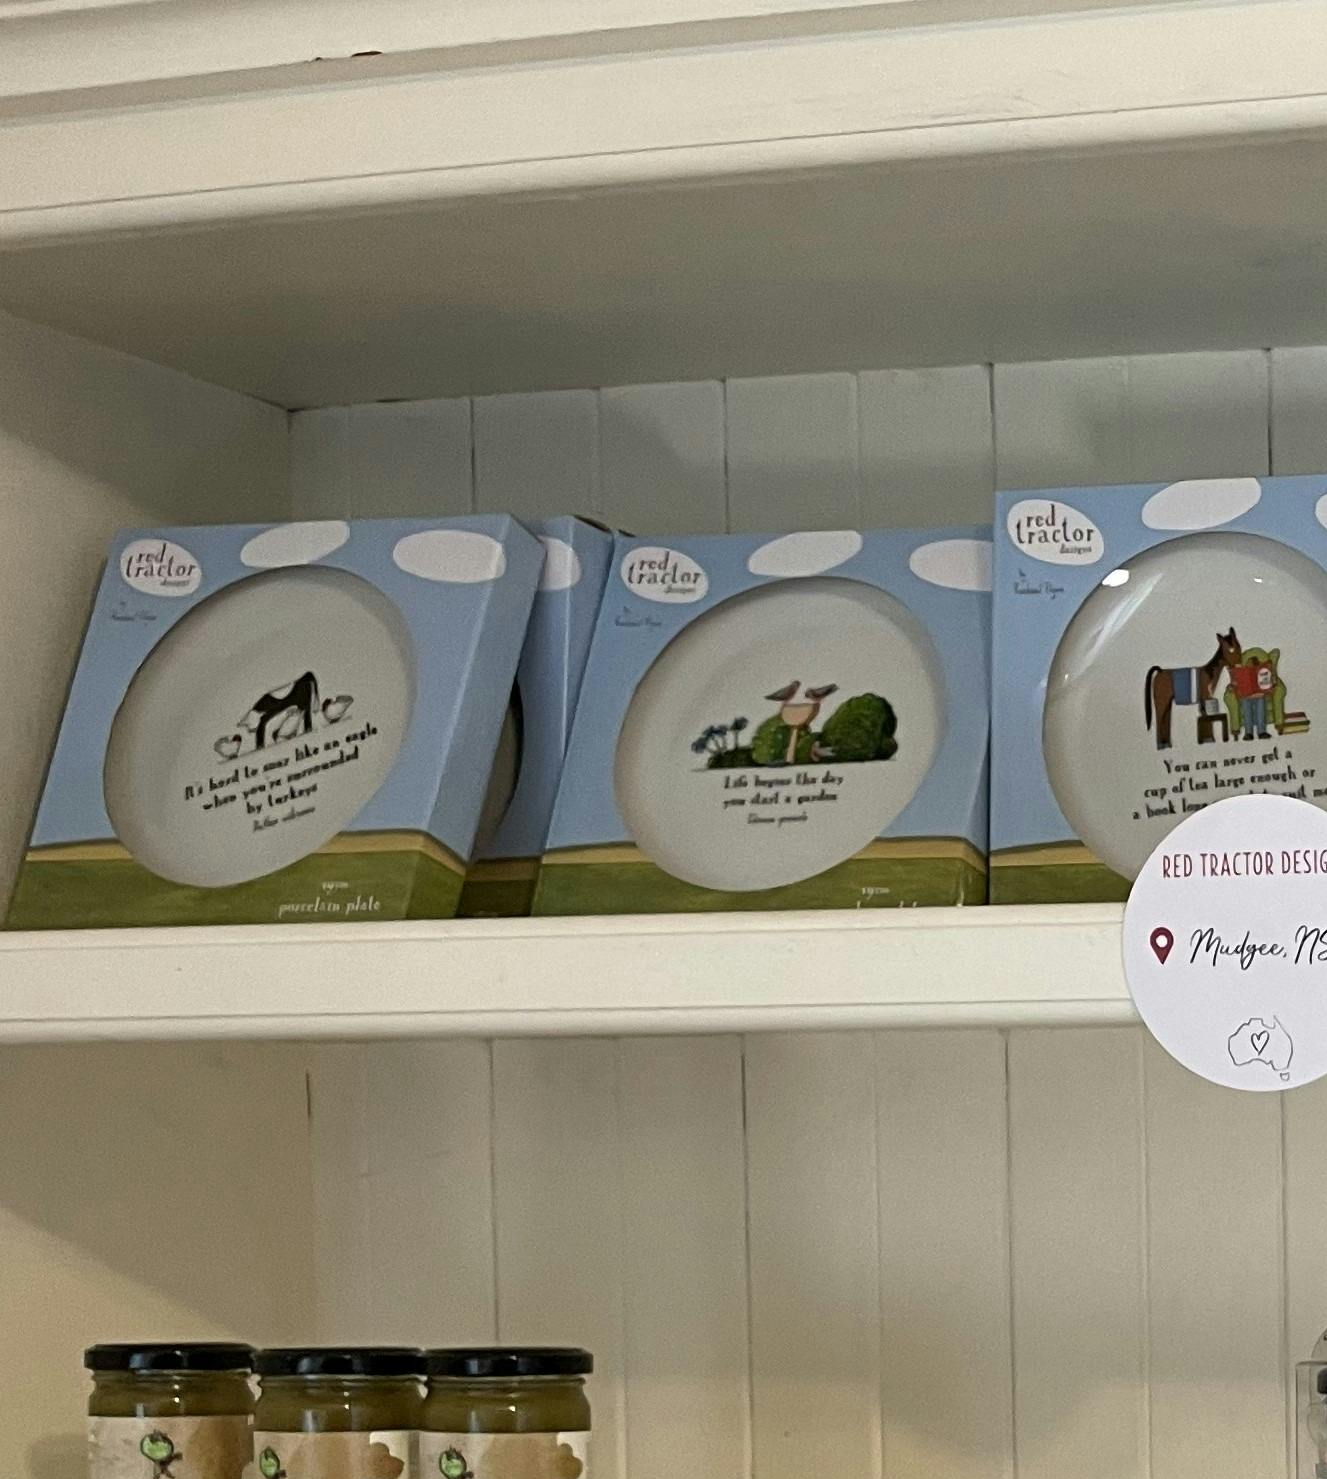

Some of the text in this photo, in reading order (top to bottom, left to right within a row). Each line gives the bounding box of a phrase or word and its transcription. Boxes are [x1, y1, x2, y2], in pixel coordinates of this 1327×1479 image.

[1015, 515, 1095, 546] tractor
[1026, 504, 1056, 529] red
[1163, 854, 1192, 878] RED
[1200, 852, 1273, 877] TRACTOR
[1190, 927, 1287, 971] Mudgee,
